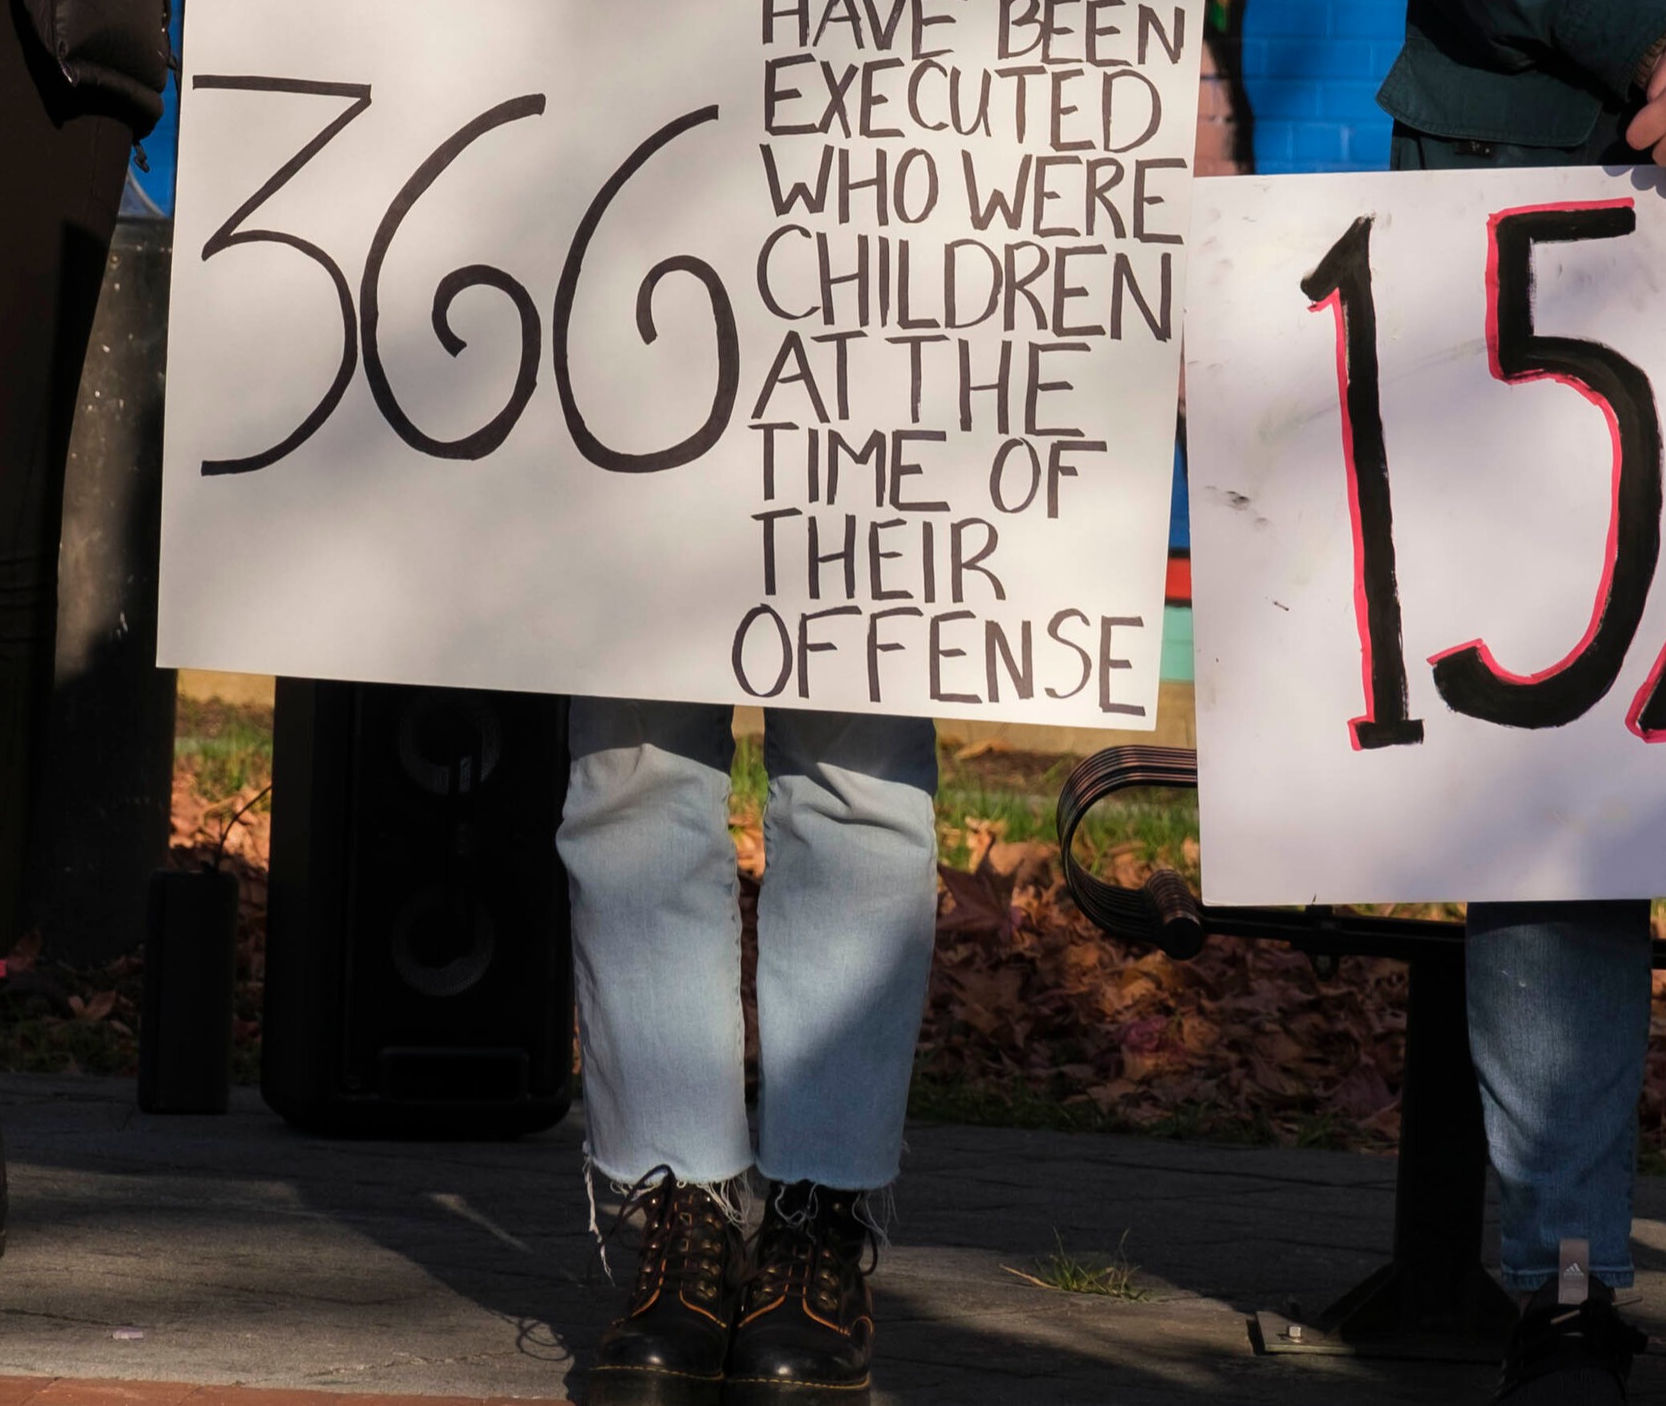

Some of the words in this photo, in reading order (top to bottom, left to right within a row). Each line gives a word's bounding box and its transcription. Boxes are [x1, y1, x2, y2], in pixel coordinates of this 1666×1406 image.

[764, 54, 1162, 154] EXECUTED
[759, 143, 939, 228] WHO
[961, 150, 1188, 245] WERE
[192, 74, 740, 478] 366
[755, 225, 1173, 342] CHILDREN
[750, 330, 874, 424] AT
[885, 336, 1092, 437] THE
[748, 423, 948, 513] TIME
[989, 438, 1108, 520] OF
[751, 508, 1007, 604] THEIR
[731, 603, 1147, 718] OFFENSE
